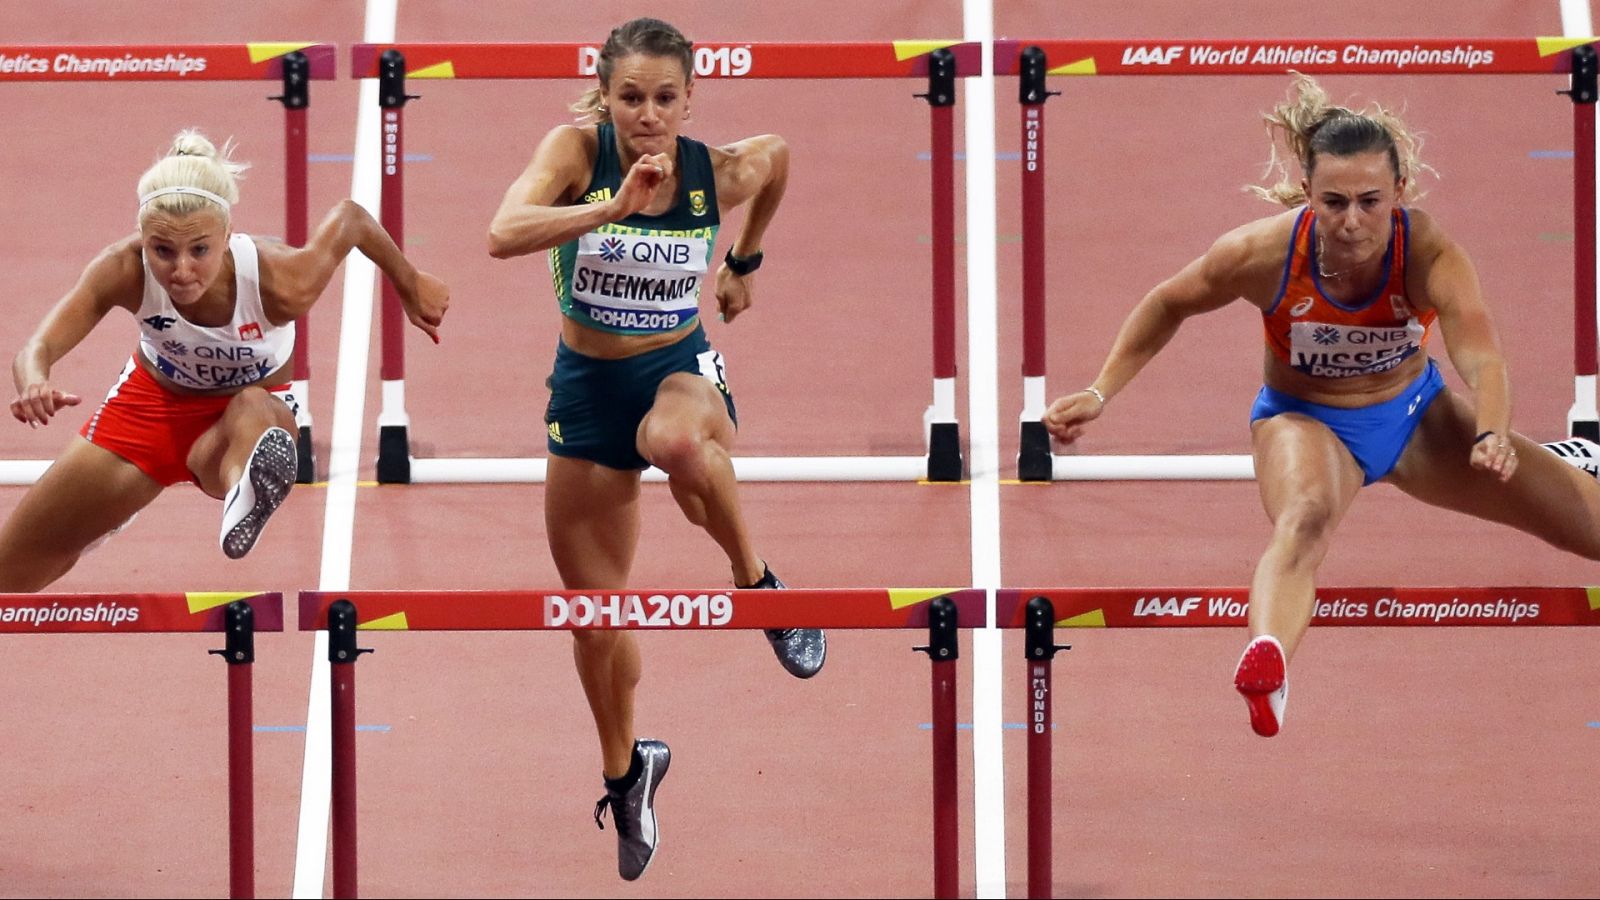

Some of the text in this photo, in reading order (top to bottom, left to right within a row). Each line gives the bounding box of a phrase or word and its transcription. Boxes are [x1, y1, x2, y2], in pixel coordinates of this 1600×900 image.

[0, 53, 207, 76] letics Championships
[578, 47, 752, 76] D019
[1121, 45, 1493, 69] IAAF World Athletics Championships
[385, 123, 398, 175] MONDO
[1026, 120, 1039, 171] MONDO
[632, 241, 690, 264] QNB
[575, 267, 697, 301] STEENKAMP
[590, 308, 679, 328] DOHA2019
[1347, 330, 1408, 344] QNB
[0, 602, 139, 626] ampionships
[544, 594, 733, 627] DOHA2019
[1134, 597, 1539, 622] IAAF Wor letics Championships
